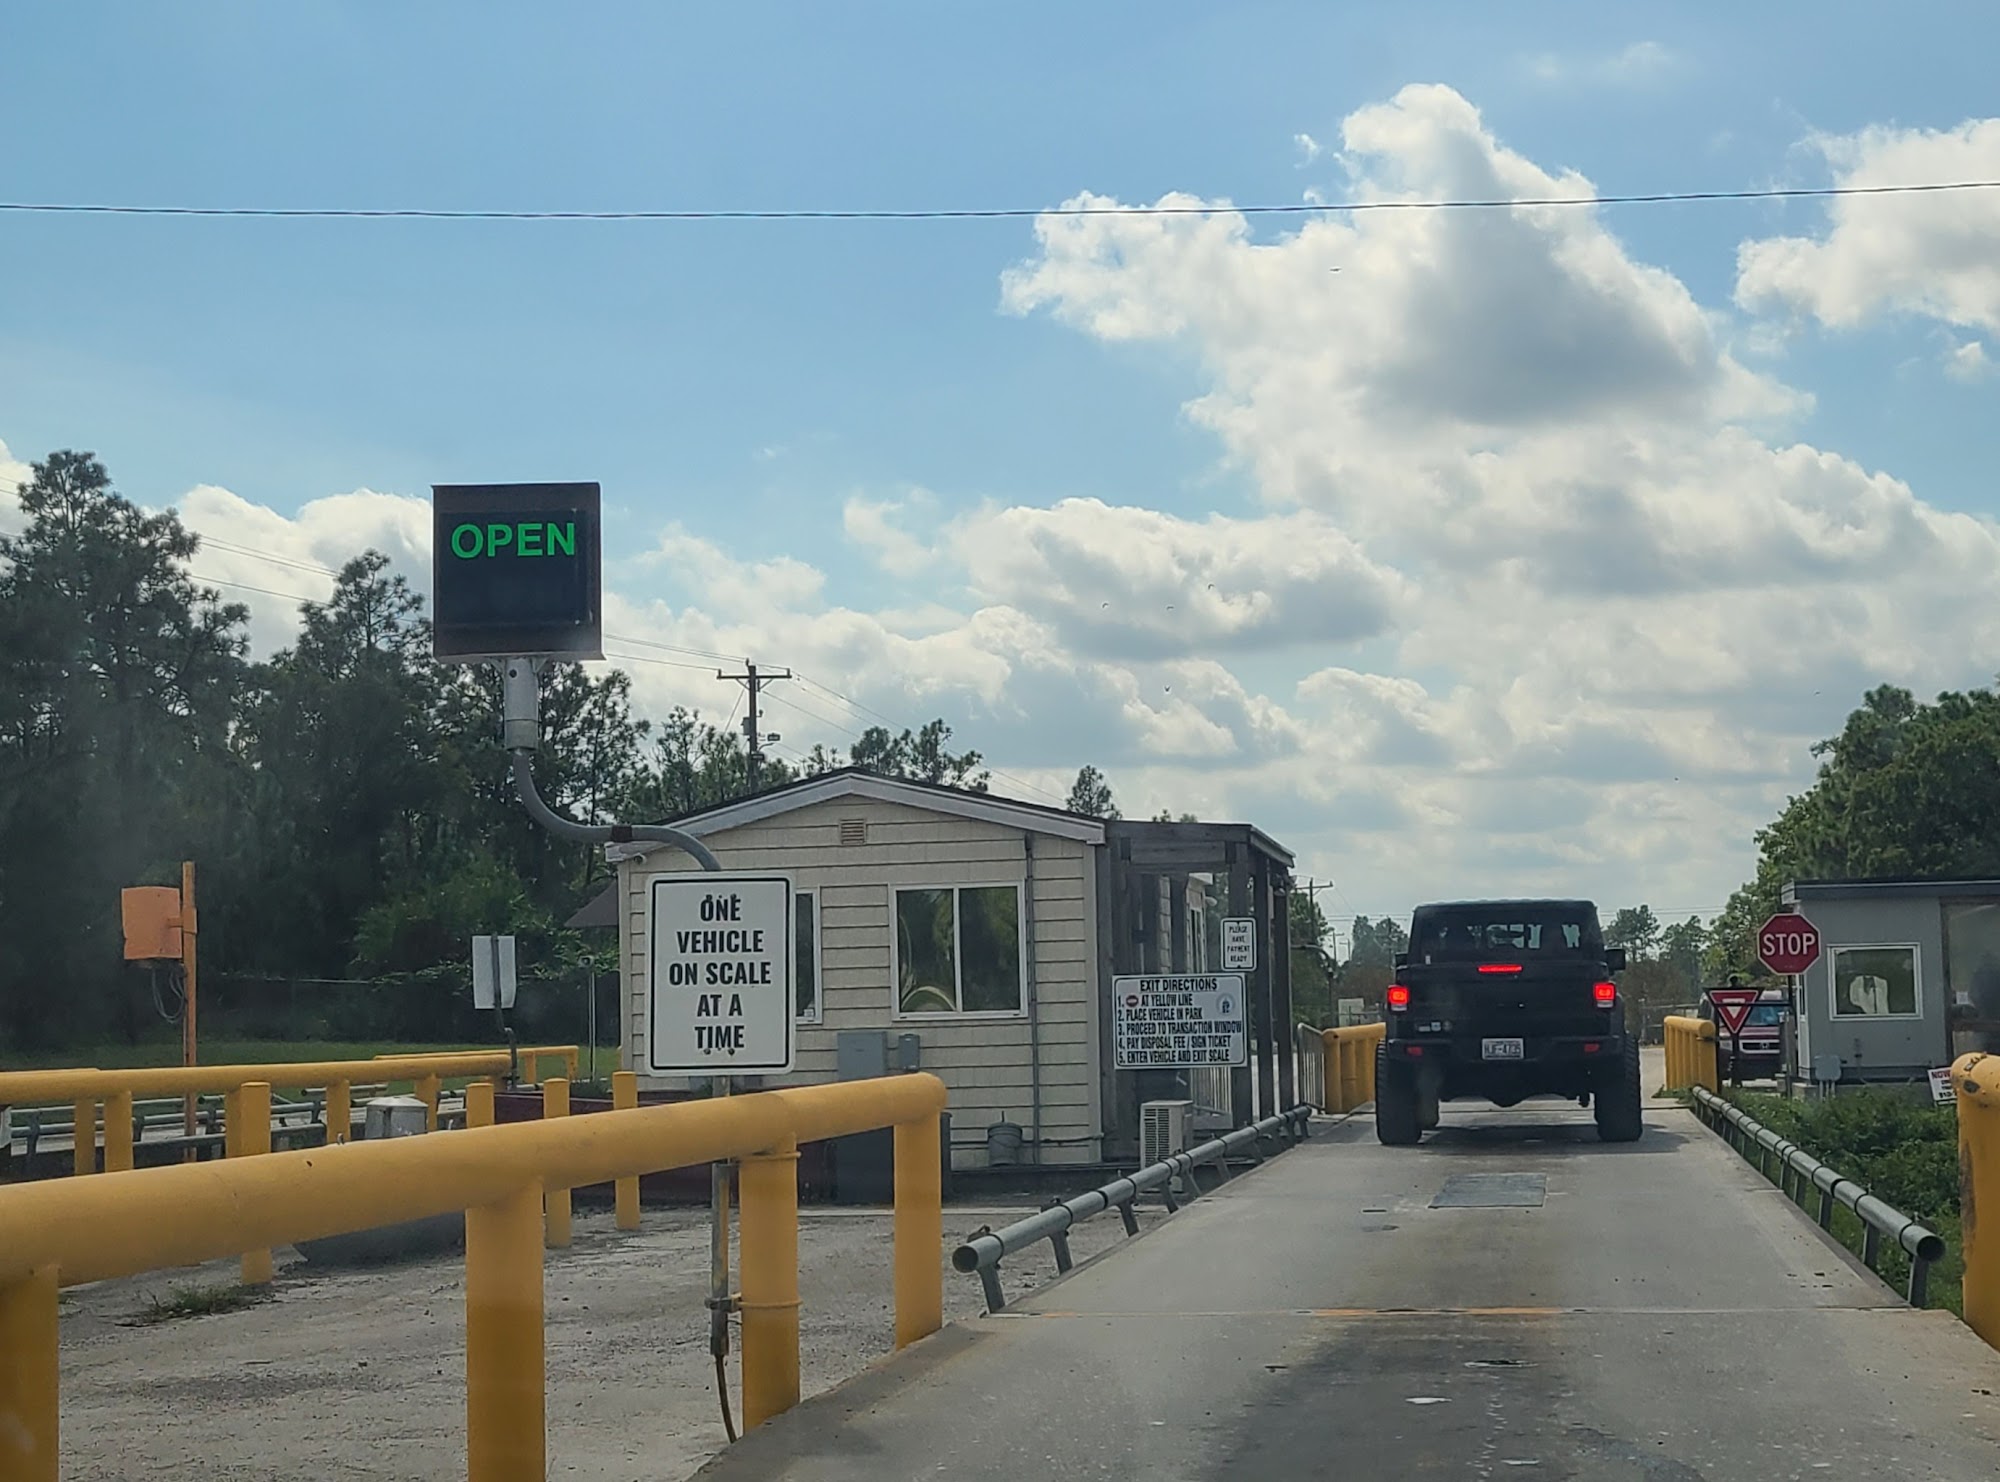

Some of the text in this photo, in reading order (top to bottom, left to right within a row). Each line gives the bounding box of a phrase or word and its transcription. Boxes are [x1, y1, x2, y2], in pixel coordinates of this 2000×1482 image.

[451, 522, 576, 559] OPEN
[700, 897, 741, 921] ONE
[677, 930, 763, 953] VEHICLE
[1762, 932, 1816, 956] STOP
[669, 962, 771, 985] ON SCALE
[1141, 978, 1217, 991] EXIT DIRECTIONS
[697, 994, 742, 1017] AT A
[1118, 996, 1124, 1007] 1.
[1141, 995, 1149, 1006] AT
[1152, 995, 1176, 1006] YELLOW
[1178, 995, 1193, 1006] LINE
[1118, 1008, 1202, 1021] 2. PLACE VEHICLE IN PARK
[695, 1026, 744, 1049] TIME
[1118, 1021, 1241, 1035] 3. PROCEED TO TRANSACTION WINDOW
[1118, 1038, 1125, 1049] 4.
[1127, 1037, 1139, 1049] PAY
[1141, 1037, 1172, 1048] DISPOSAL
[1174, 1036, 1184, 1048] FEE
[1192, 1036, 1206, 1048] SIGN
[1208, 1036, 1231, 1047] TICKET
[1119, 1049, 1229, 1063] 5. ENTER VEHICLE AND EXIT SCALE
